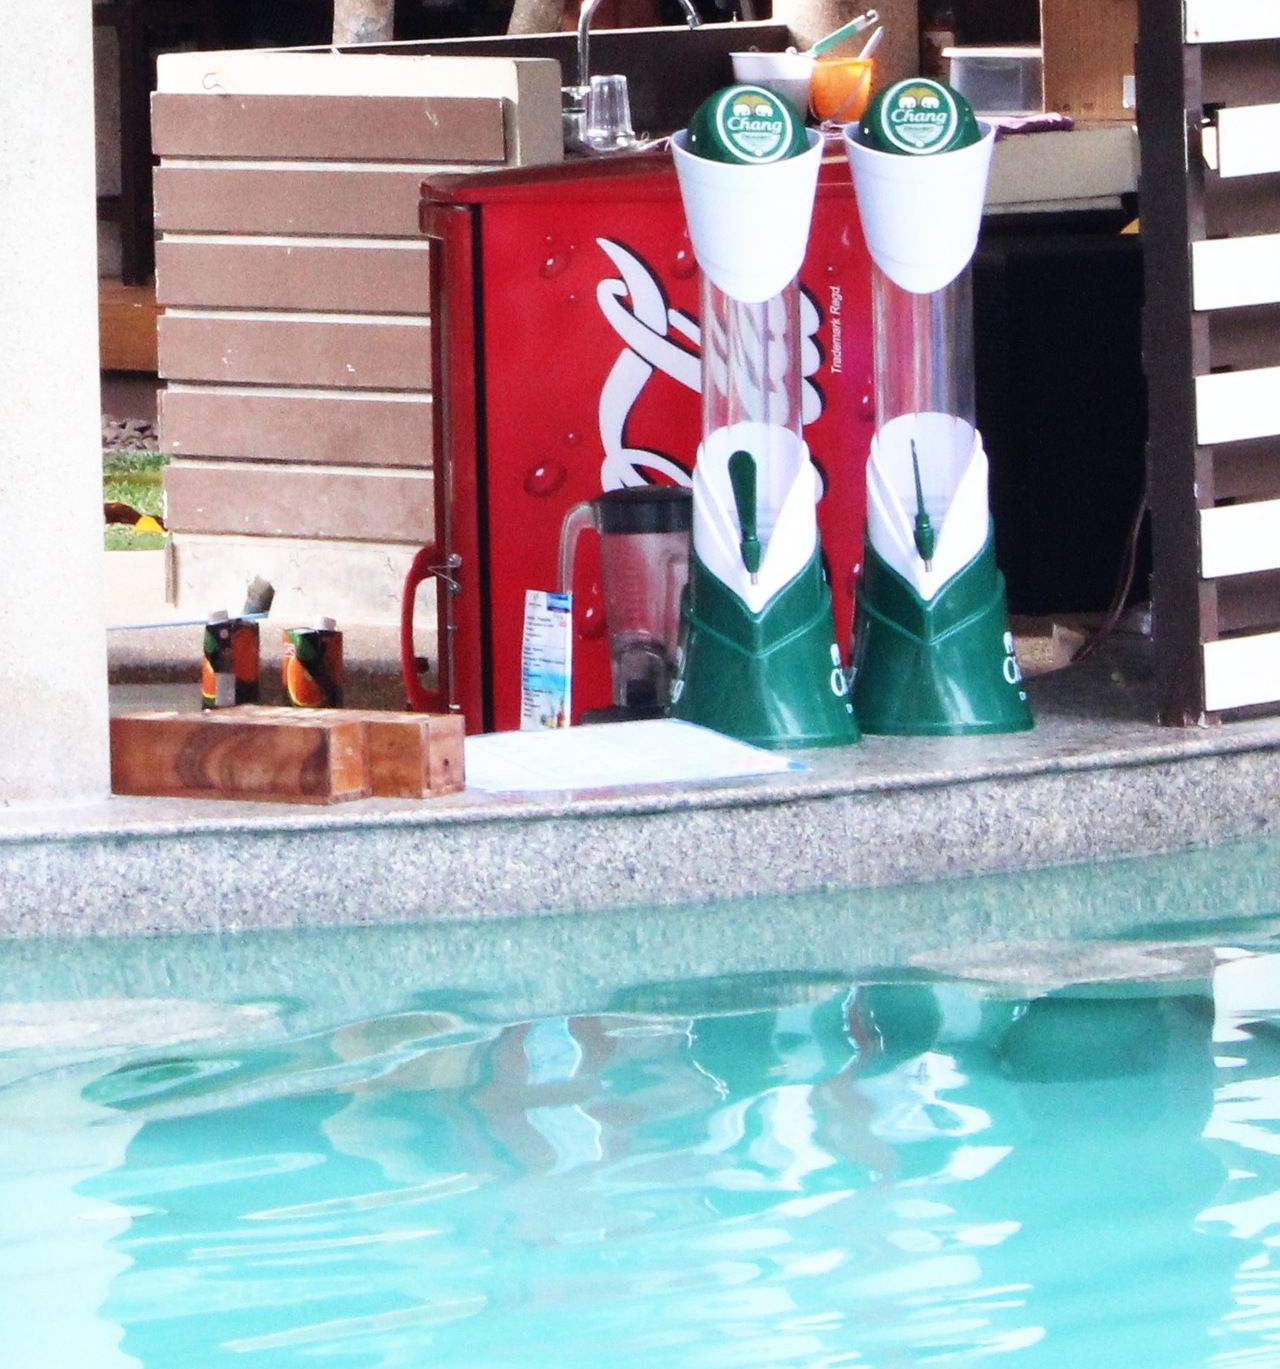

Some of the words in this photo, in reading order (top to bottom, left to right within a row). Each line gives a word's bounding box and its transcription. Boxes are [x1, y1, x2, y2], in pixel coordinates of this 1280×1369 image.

[726, 115, 783, 134] Chang
[890, 107, 948, 125] Chang
[830, 318, 843, 373] Trademark
